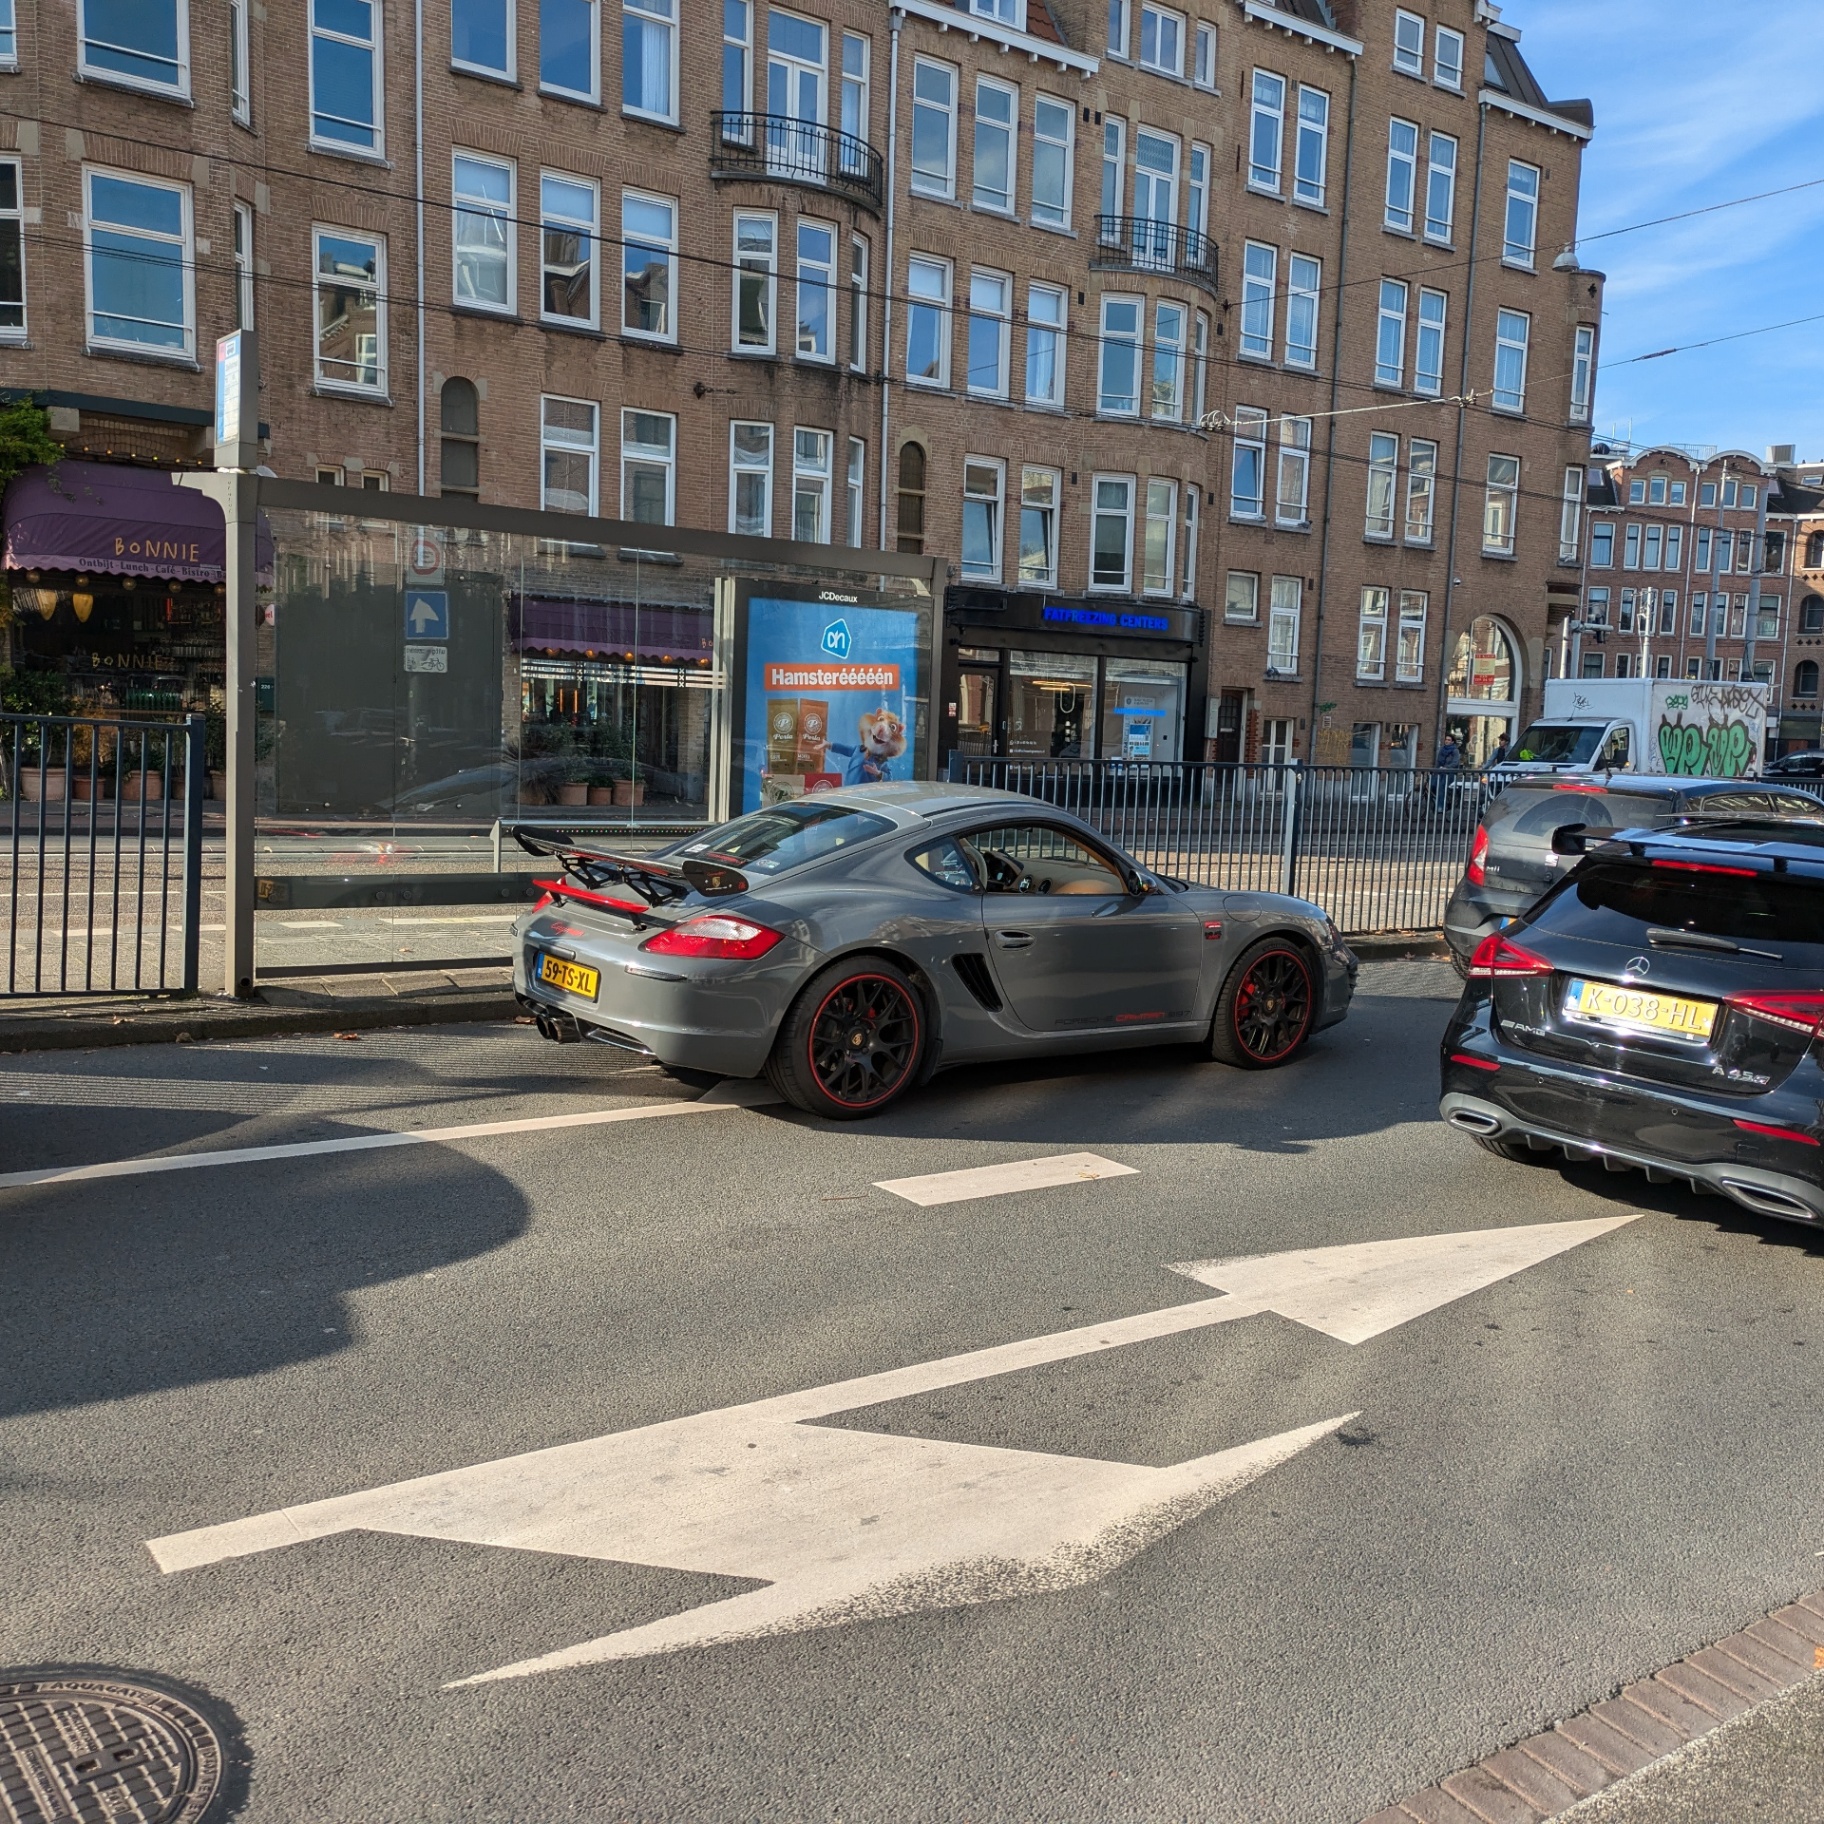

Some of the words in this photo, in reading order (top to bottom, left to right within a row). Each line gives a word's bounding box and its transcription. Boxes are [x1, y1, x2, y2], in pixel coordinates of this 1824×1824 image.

[79, 558, 114, 569] Ontbijt
[120, 562, 149, 573] Lunch
[155, 564, 176, 575] Café
[182, 566, 210, 578] Bistro
[818, 591, 858, 603] JCDecaux
[1044, 607, 1117, 626] FATFREEZING
[1120, 614, 1169, 631] CENTERS
[771, 667, 893, 685] Hamsterééééén
[545, 960, 592, 993] 59-TS-XL
[1586, 988, 1702, 1031] K-038-HL
[1514, 1022, 1546, 1037] AMG
[1712, 1066, 1725, 1076] A
[51, 1682, 149, 1699] AQUAGATE
